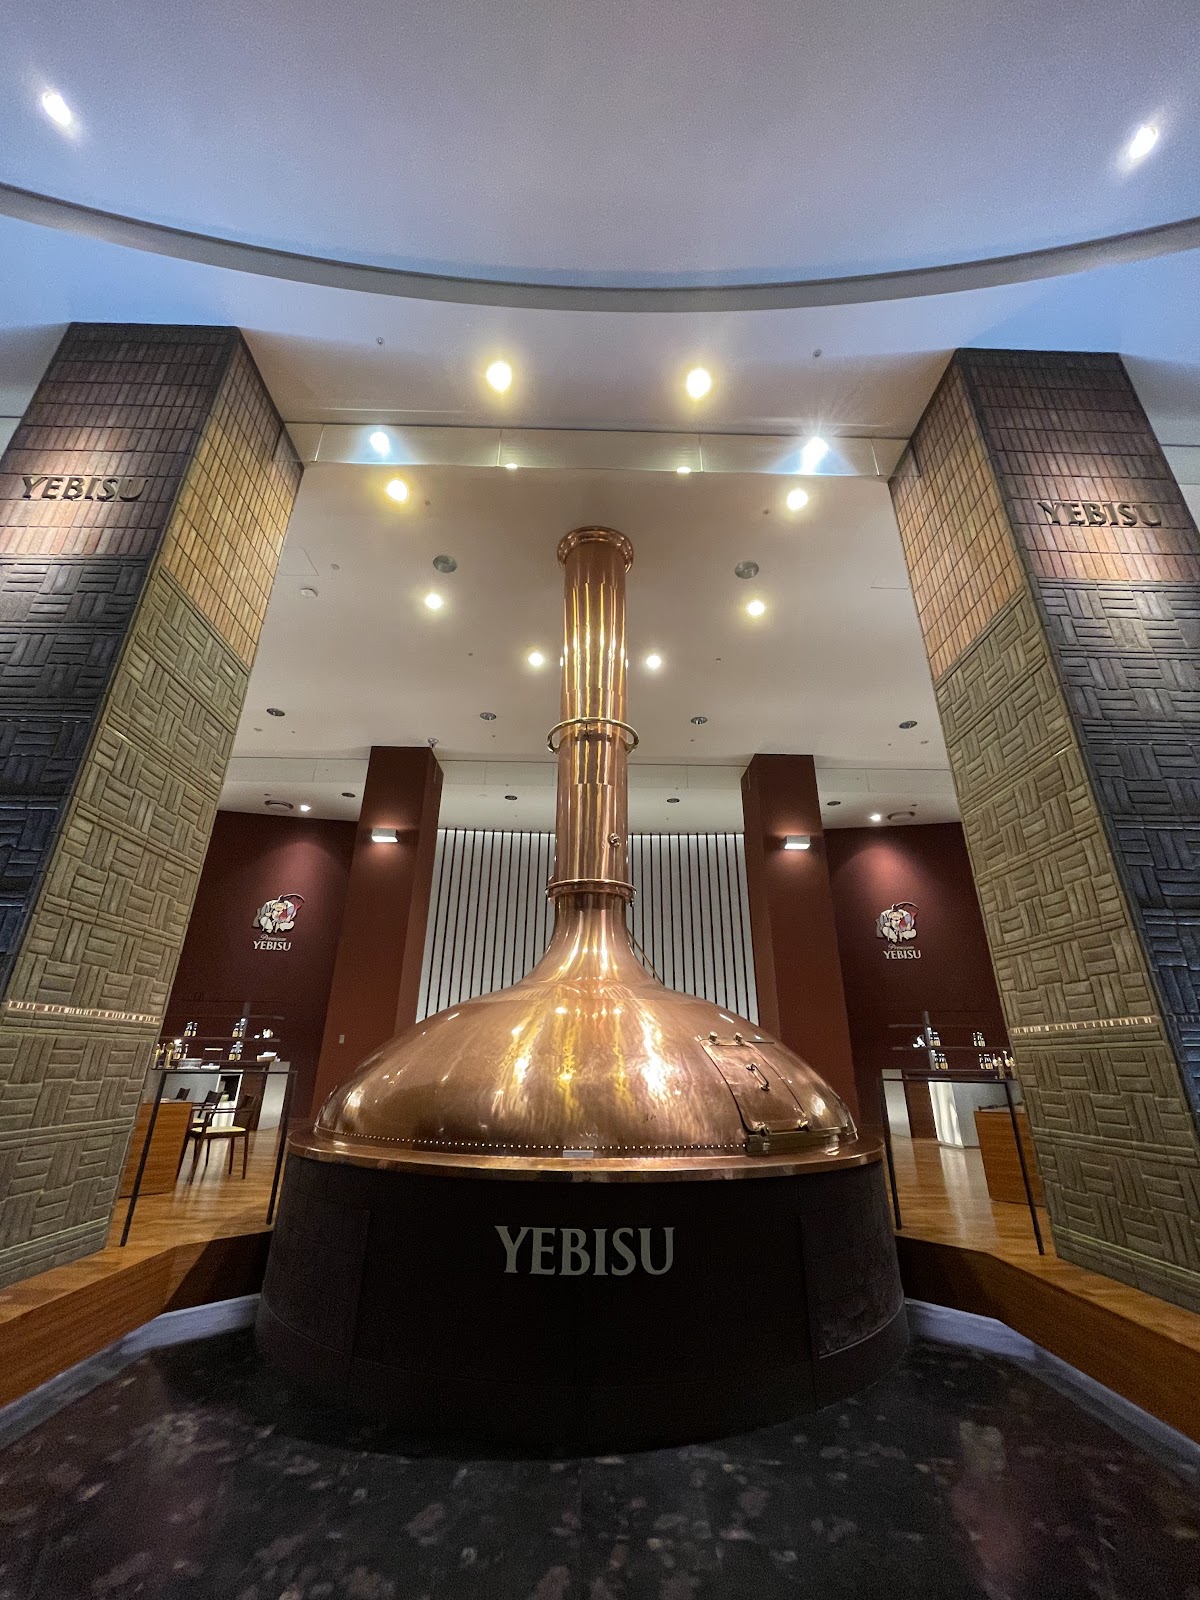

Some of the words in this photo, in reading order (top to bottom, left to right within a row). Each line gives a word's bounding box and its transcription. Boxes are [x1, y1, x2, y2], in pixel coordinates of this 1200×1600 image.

[22, 476, 149, 500] YEBISU
[1037, 501, 1162, 527] YEBISU
[253, 941, 292, 951] YEBISU
[883, 950, 921, 960] YEBISU
[494, 1225, 675, 1276] YEBISU
